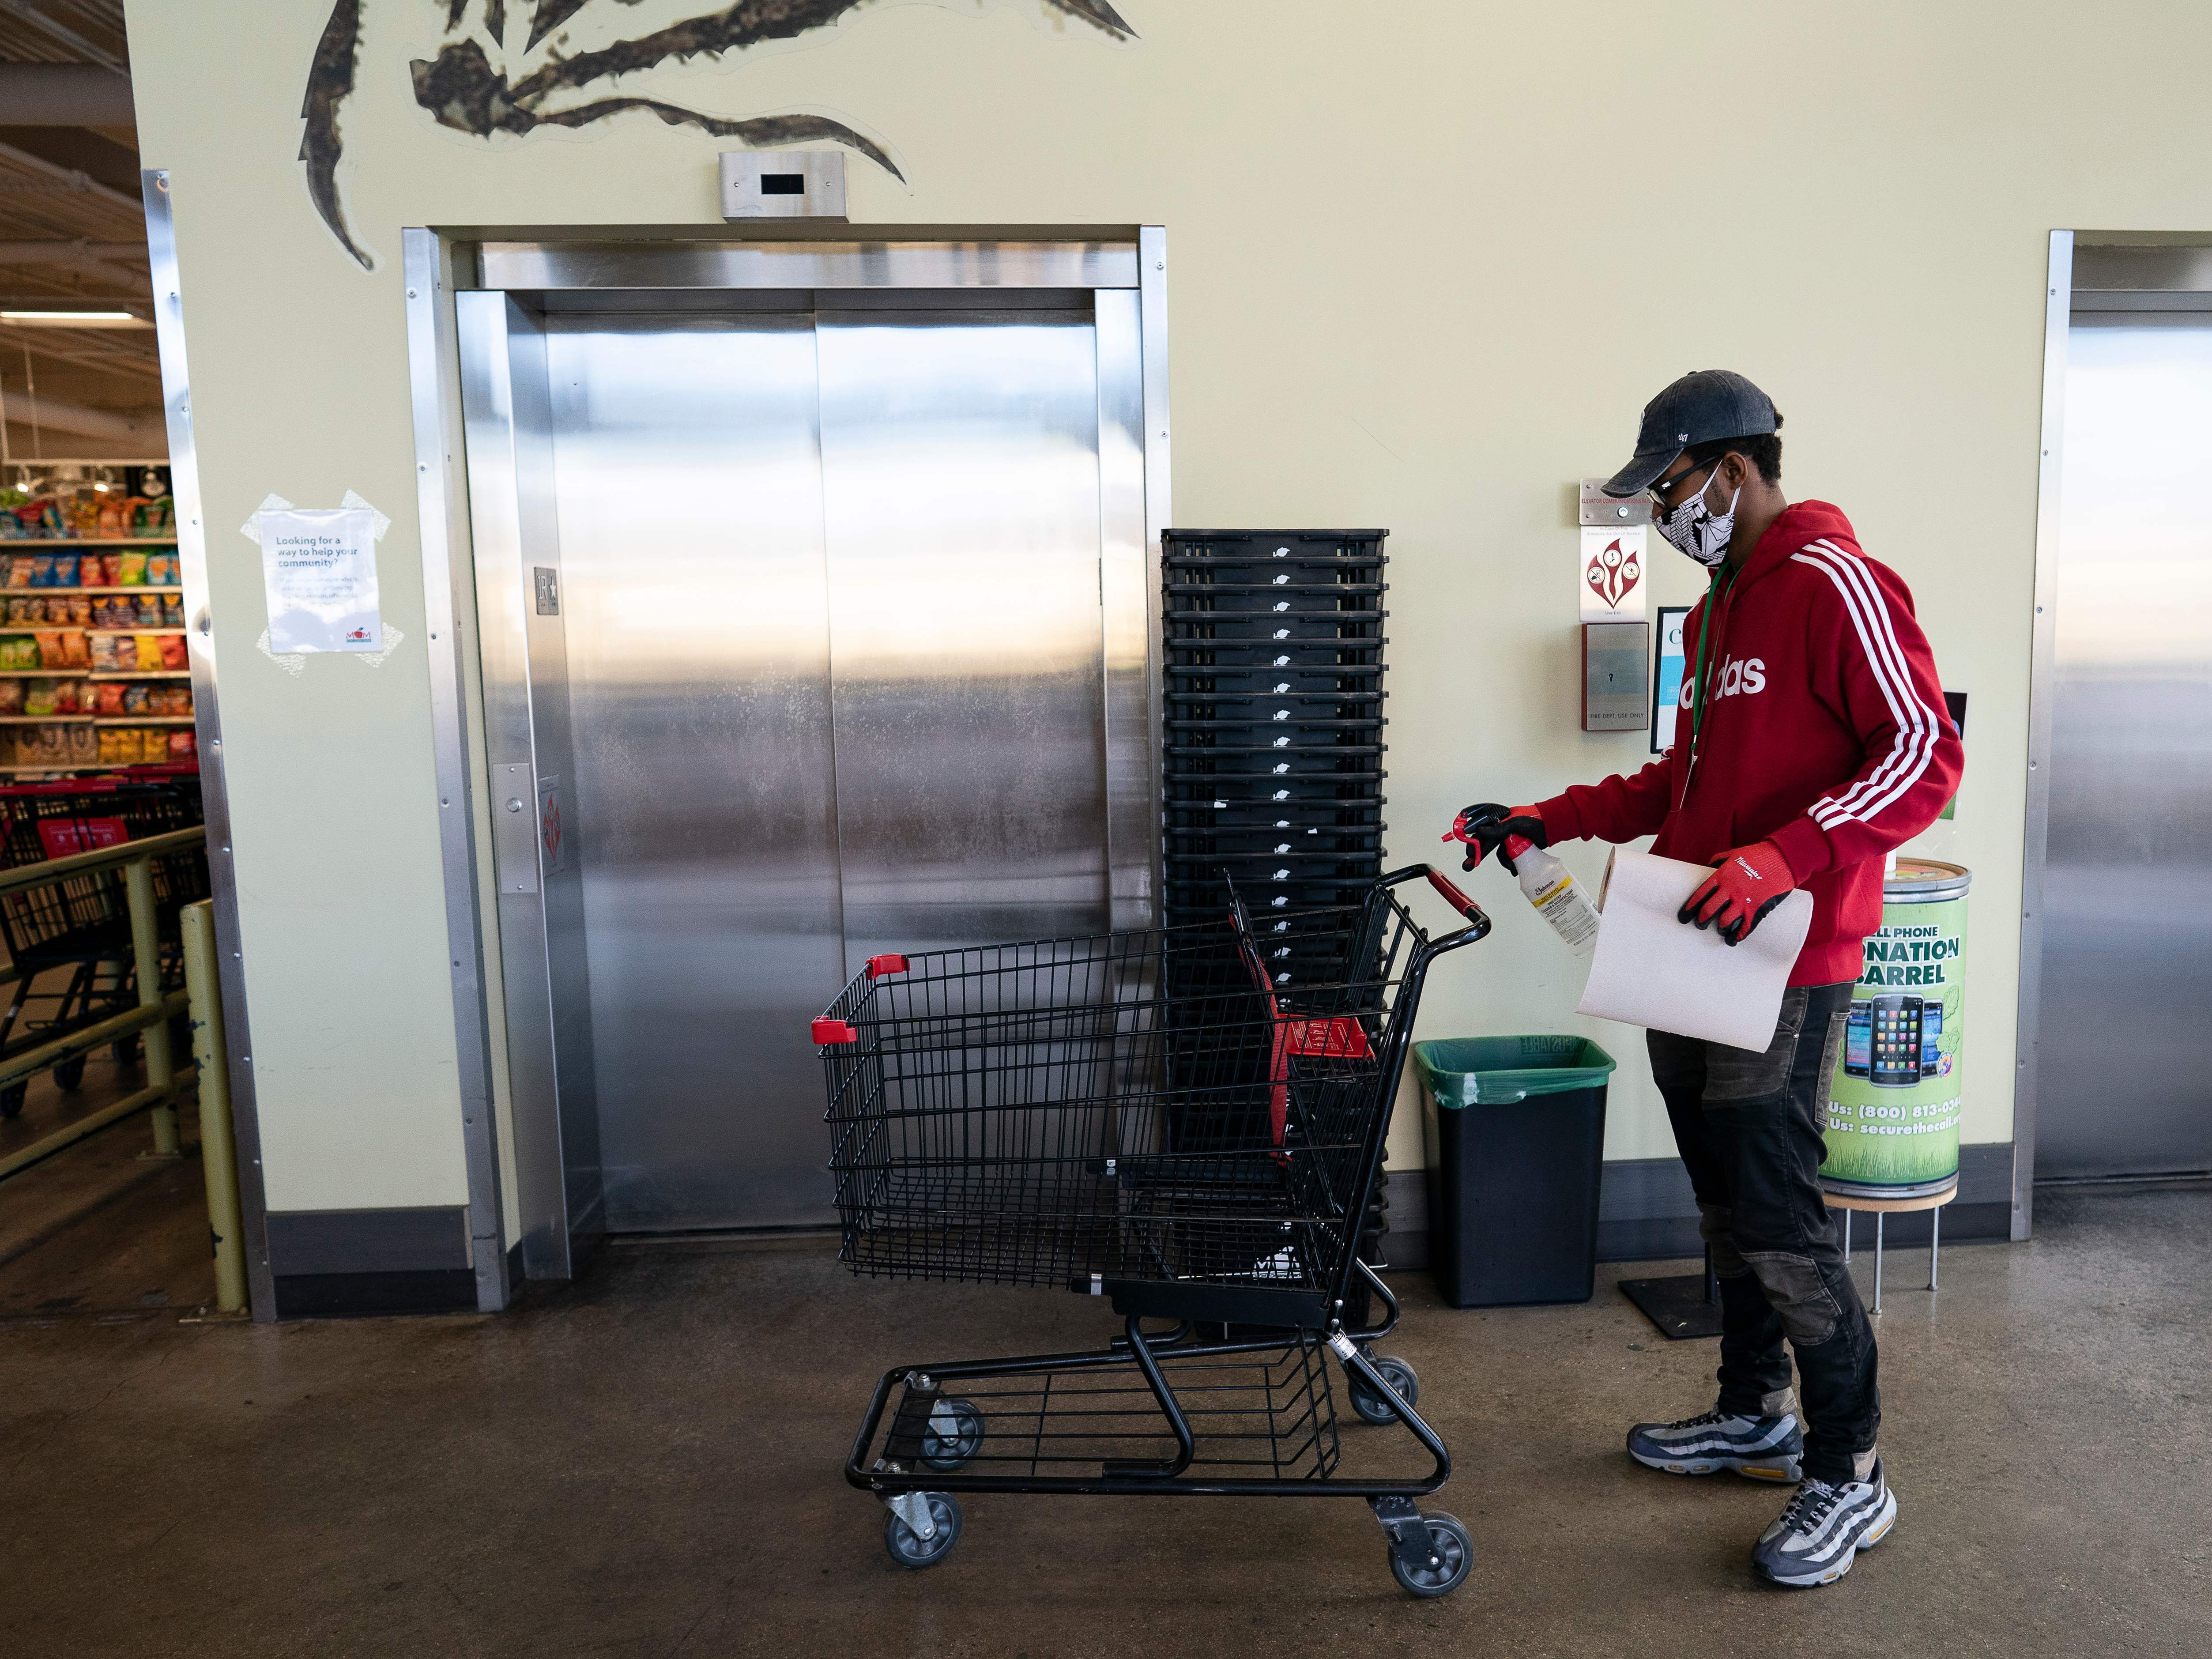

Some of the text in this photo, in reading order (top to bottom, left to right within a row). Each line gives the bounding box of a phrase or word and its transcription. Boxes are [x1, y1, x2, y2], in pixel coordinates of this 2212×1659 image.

[276, 536, 316, 546] Looking
[319, 536, 332, 544] for
[312, 547, 333, 557] help
[279, 558, 338, 568] community?
[1669, 628, 1682, 644] C
[1680, 654, 1766, 709] adas
[1535, 880, 1555, 896] Johnson
[1547, 894, 1562, 906] ONE-STEP
[1893, 926, 1938, 938] PHONE
[1862, 937, 1959, 962] NATION
[1828, 1101, 1853, 1116] Us:
[1859, 1104, 1907, 1121] (800)
[1829, 1112, 1961, 1135] Us: securethecall.or
